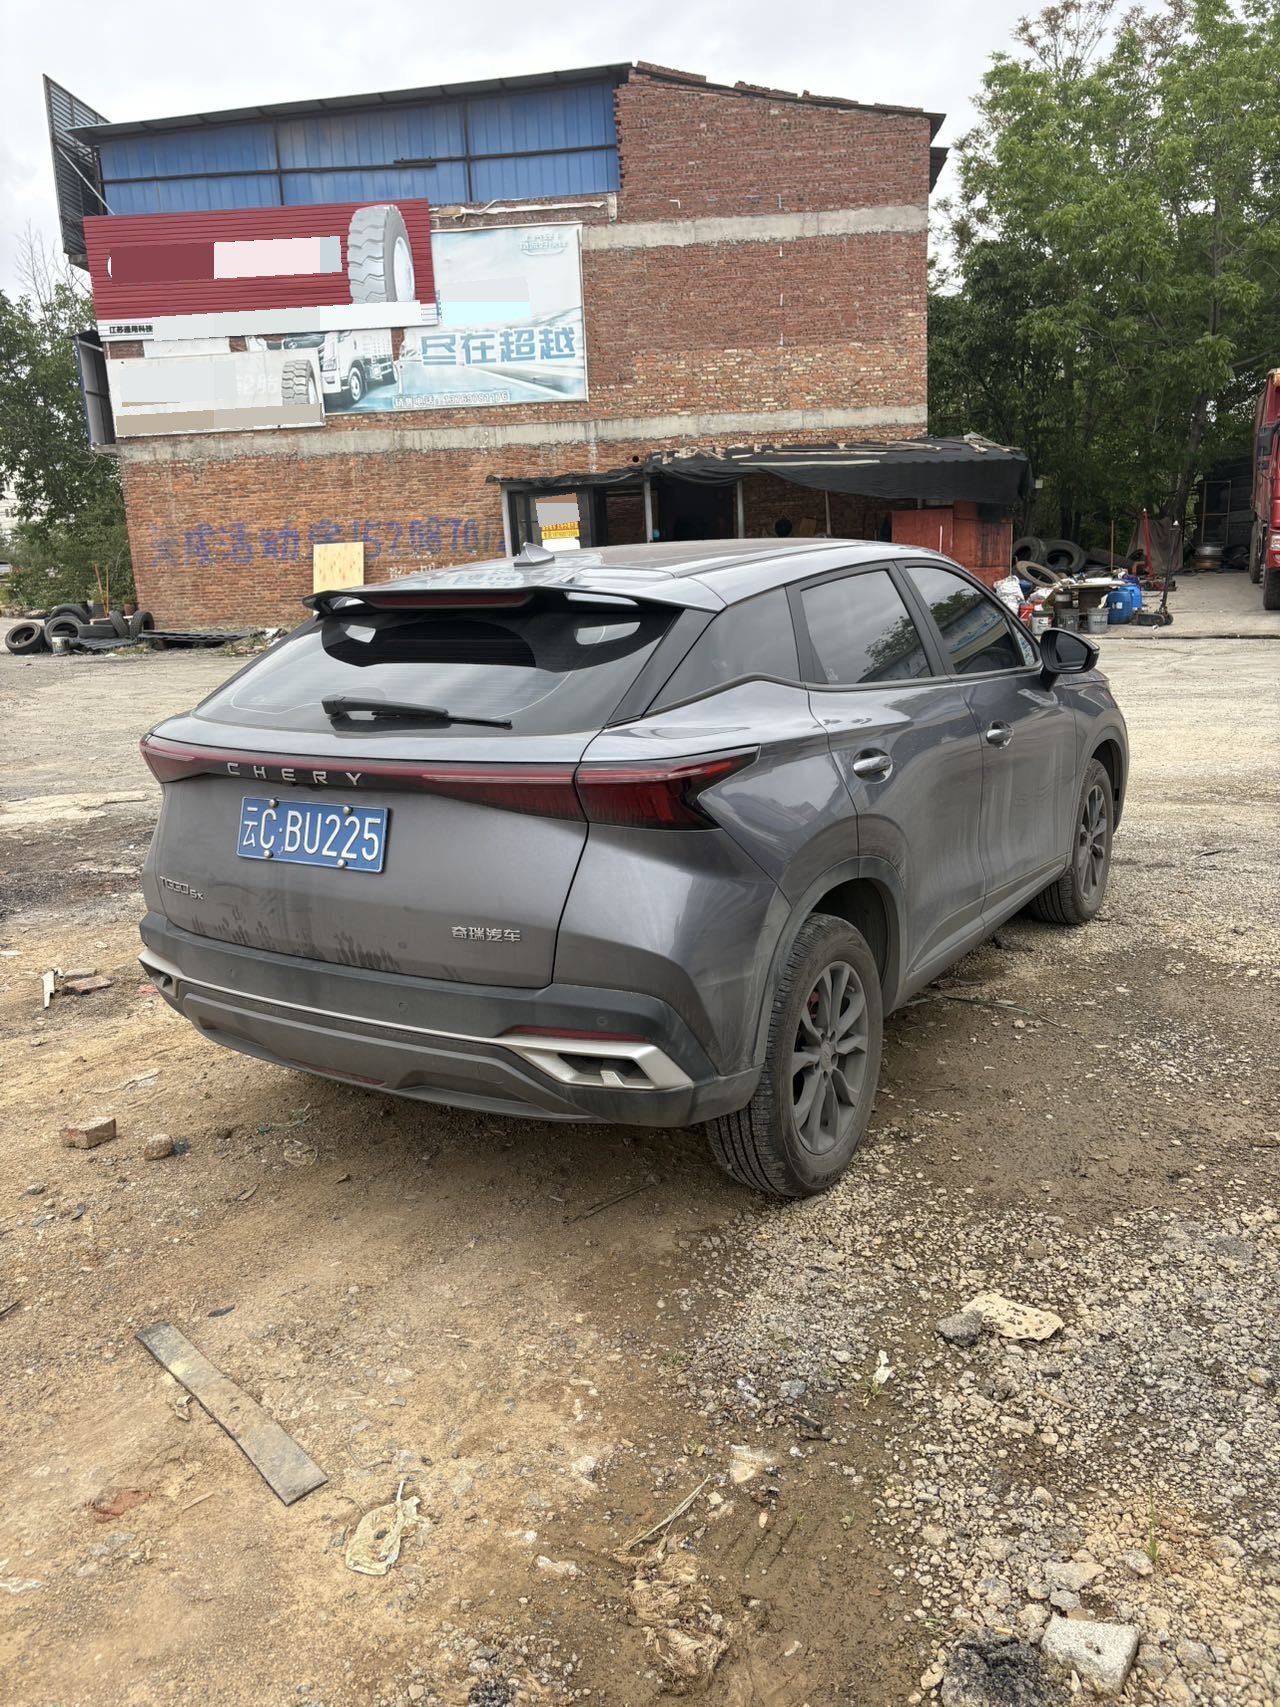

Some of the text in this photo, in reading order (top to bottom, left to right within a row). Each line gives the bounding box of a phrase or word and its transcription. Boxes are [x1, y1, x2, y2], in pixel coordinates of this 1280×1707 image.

[421, 326, 576, 366] 尽在超越
[227, 762, 362, 786] CHERY
[451, 925, 521, 942] 奇瑞汽车
